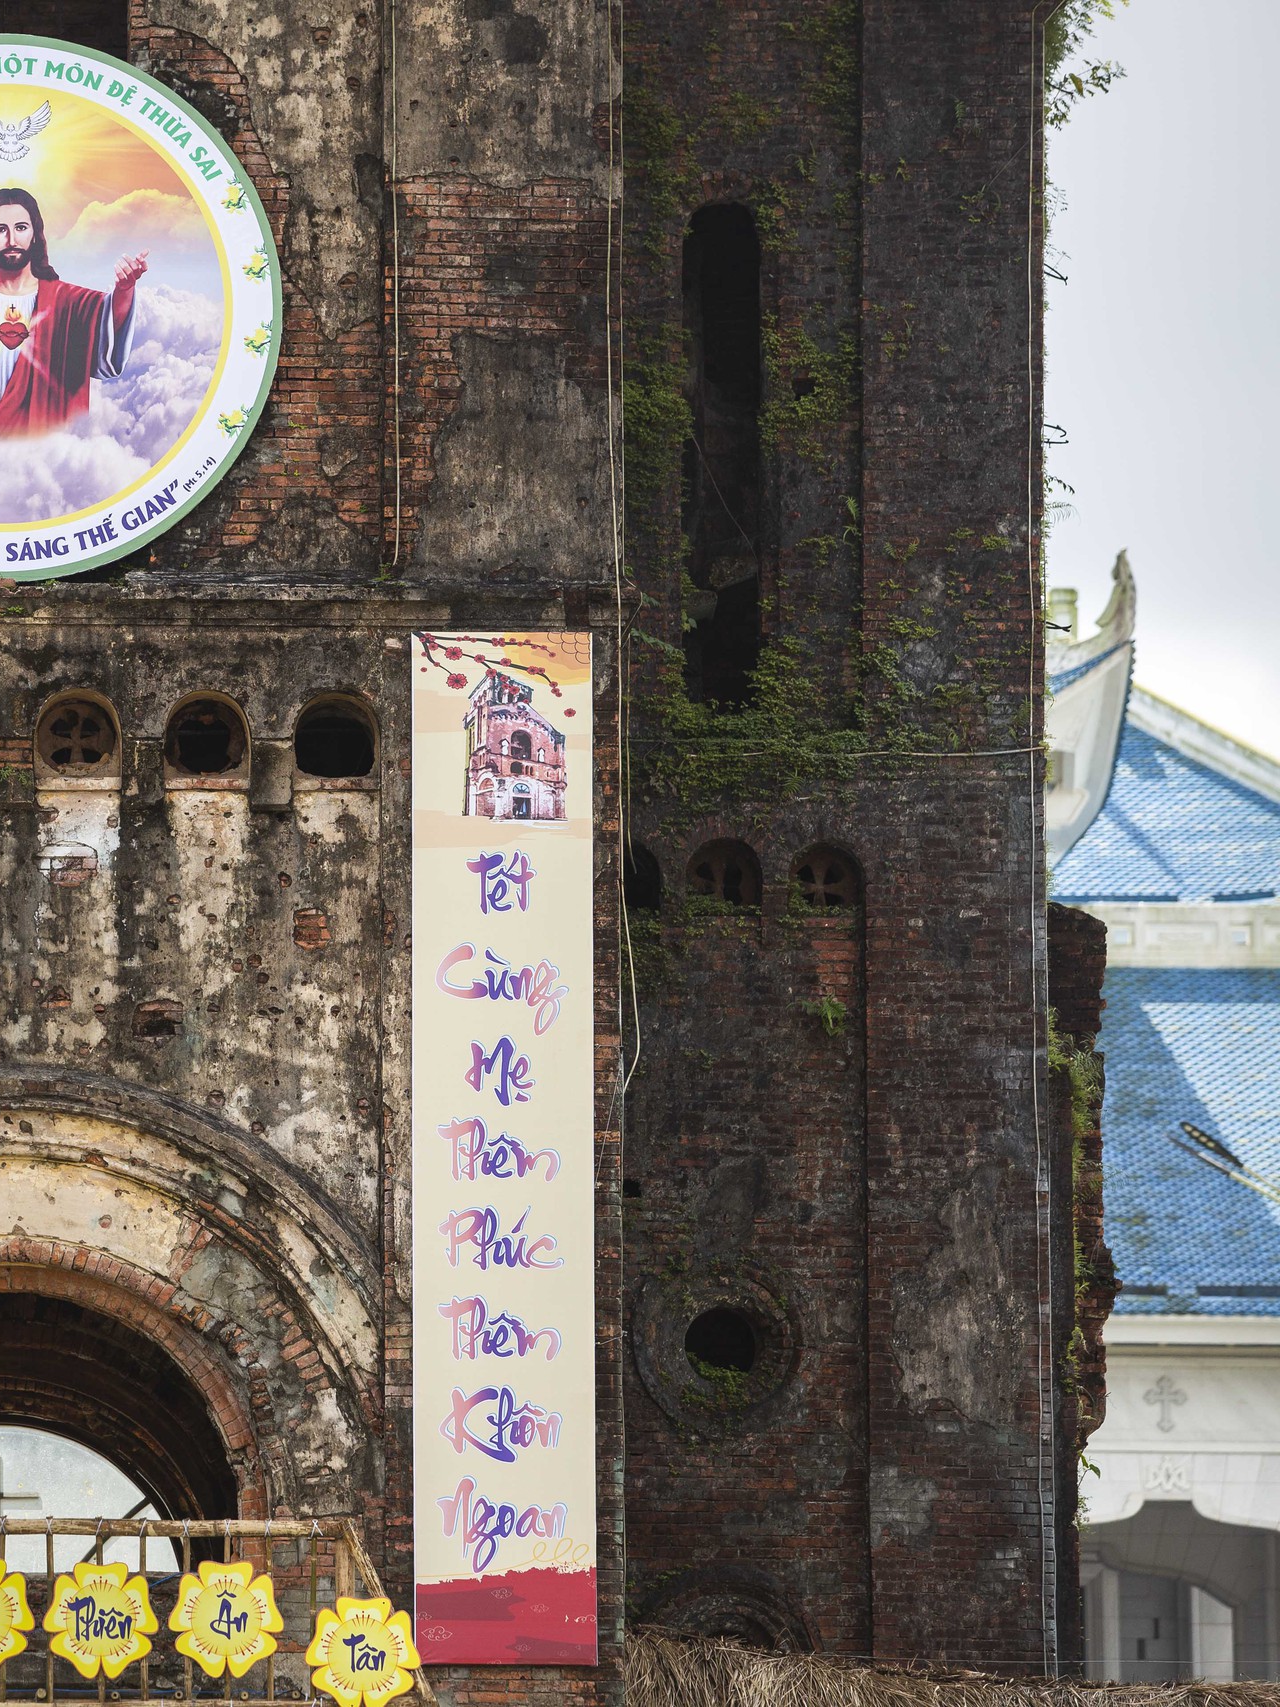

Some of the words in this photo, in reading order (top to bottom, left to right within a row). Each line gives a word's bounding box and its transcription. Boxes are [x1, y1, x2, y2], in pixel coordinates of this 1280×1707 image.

[43, 60, 104, 91] MÔN
[106, 80, 138, 107] ĐỆ
[139, 97, 193, 149] THỪA
[188, 146, 223, 181] SAI
[5, 536, 69, 562] SÁNG
[73, 513, 119, 551] THẾ
[466, 849, 537, 915] Tết
[435, 941, 569, 1037] Cùng
[464, 1034, 536, 1107] Mẹ
[436, 1115, 561, 1183] Thêm
[437, 1204, 565, 1272] Phúc
[437, 1294, 561, 1362] Thêm
[440, 1385, 564, 1465] Khôn
[436, 1474, 569, 1574] Ngoan
[67, 1596, 133, 1641] Thiên
[209, 1589, 248, 1640] Ân
[342, 1633, 387, 1673] Tân
